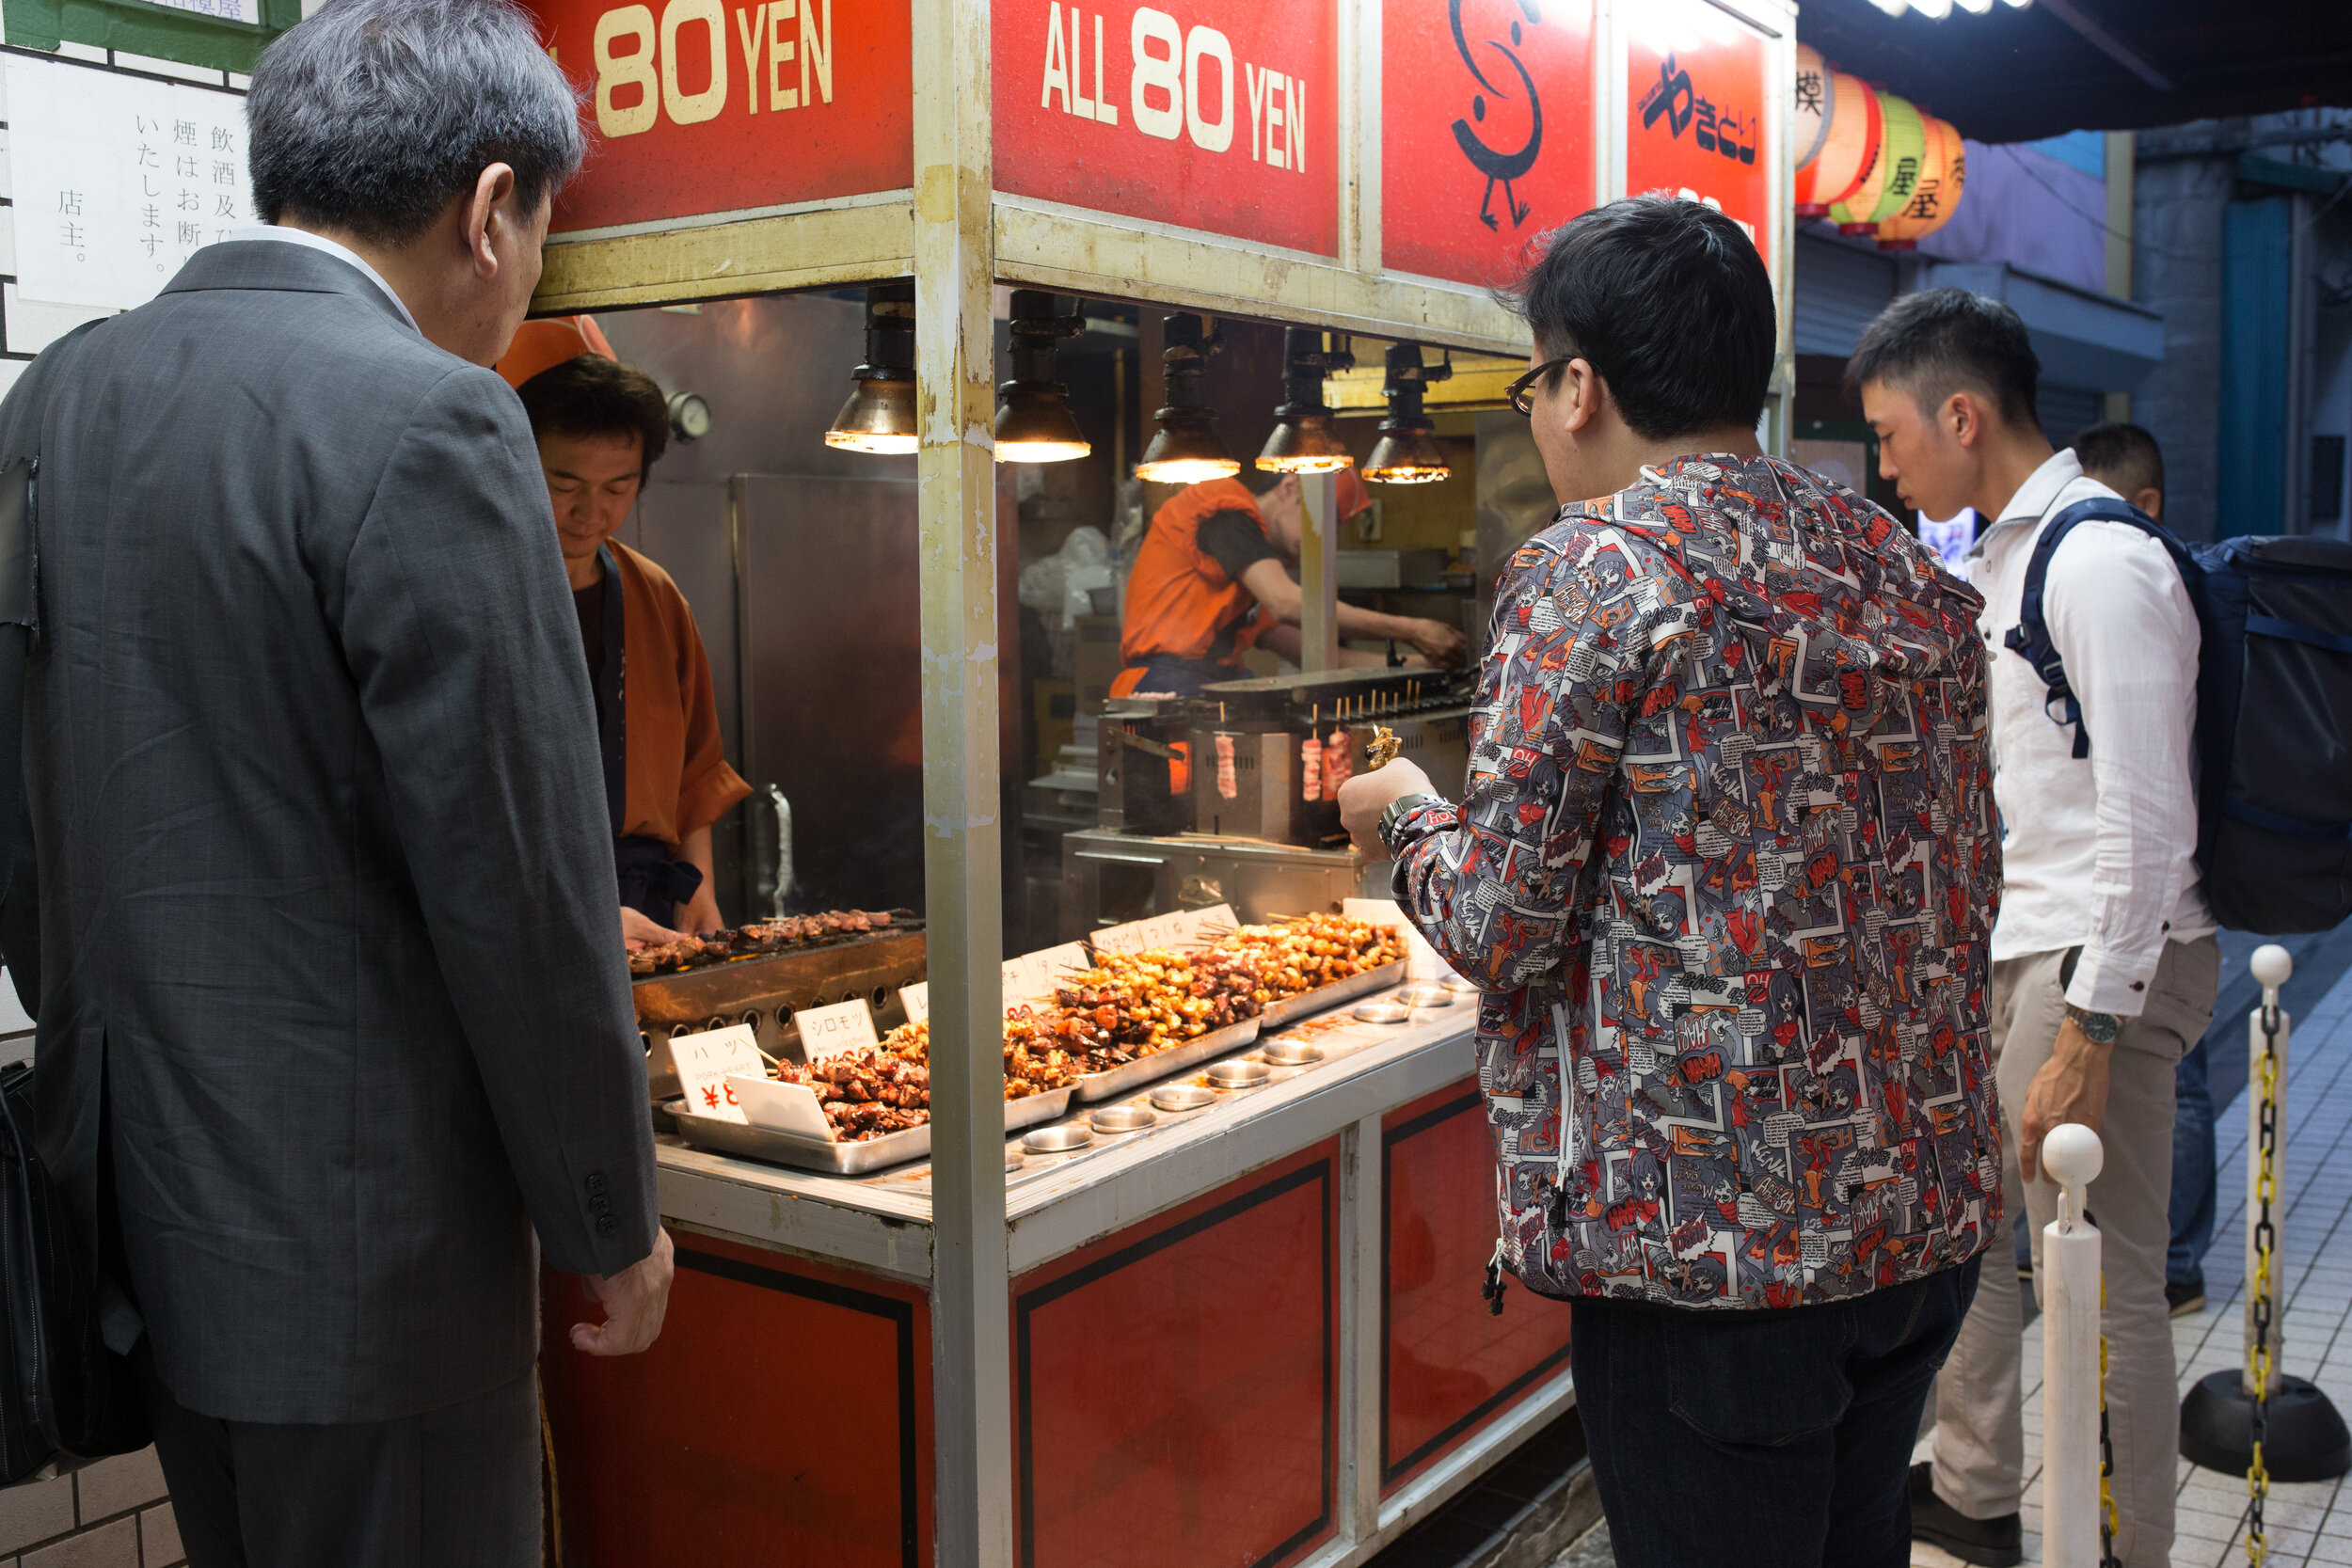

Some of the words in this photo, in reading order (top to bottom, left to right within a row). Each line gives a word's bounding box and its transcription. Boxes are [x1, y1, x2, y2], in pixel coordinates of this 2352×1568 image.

[594, 0, 728, 138] 80
[736, 0, 833, 115] YEN
[1041, 1, 1118, 126] ALL
[1131, 7, 1234, 153] 80
[1246, 62, 1305, 174] YEN
[58, 189, 86, 262] 店主。
[135, 114, 165, 272] いたします。
[173, 119, 201, 263] 煙はお断
[812, 1013, 863, 1037] シロモツ
